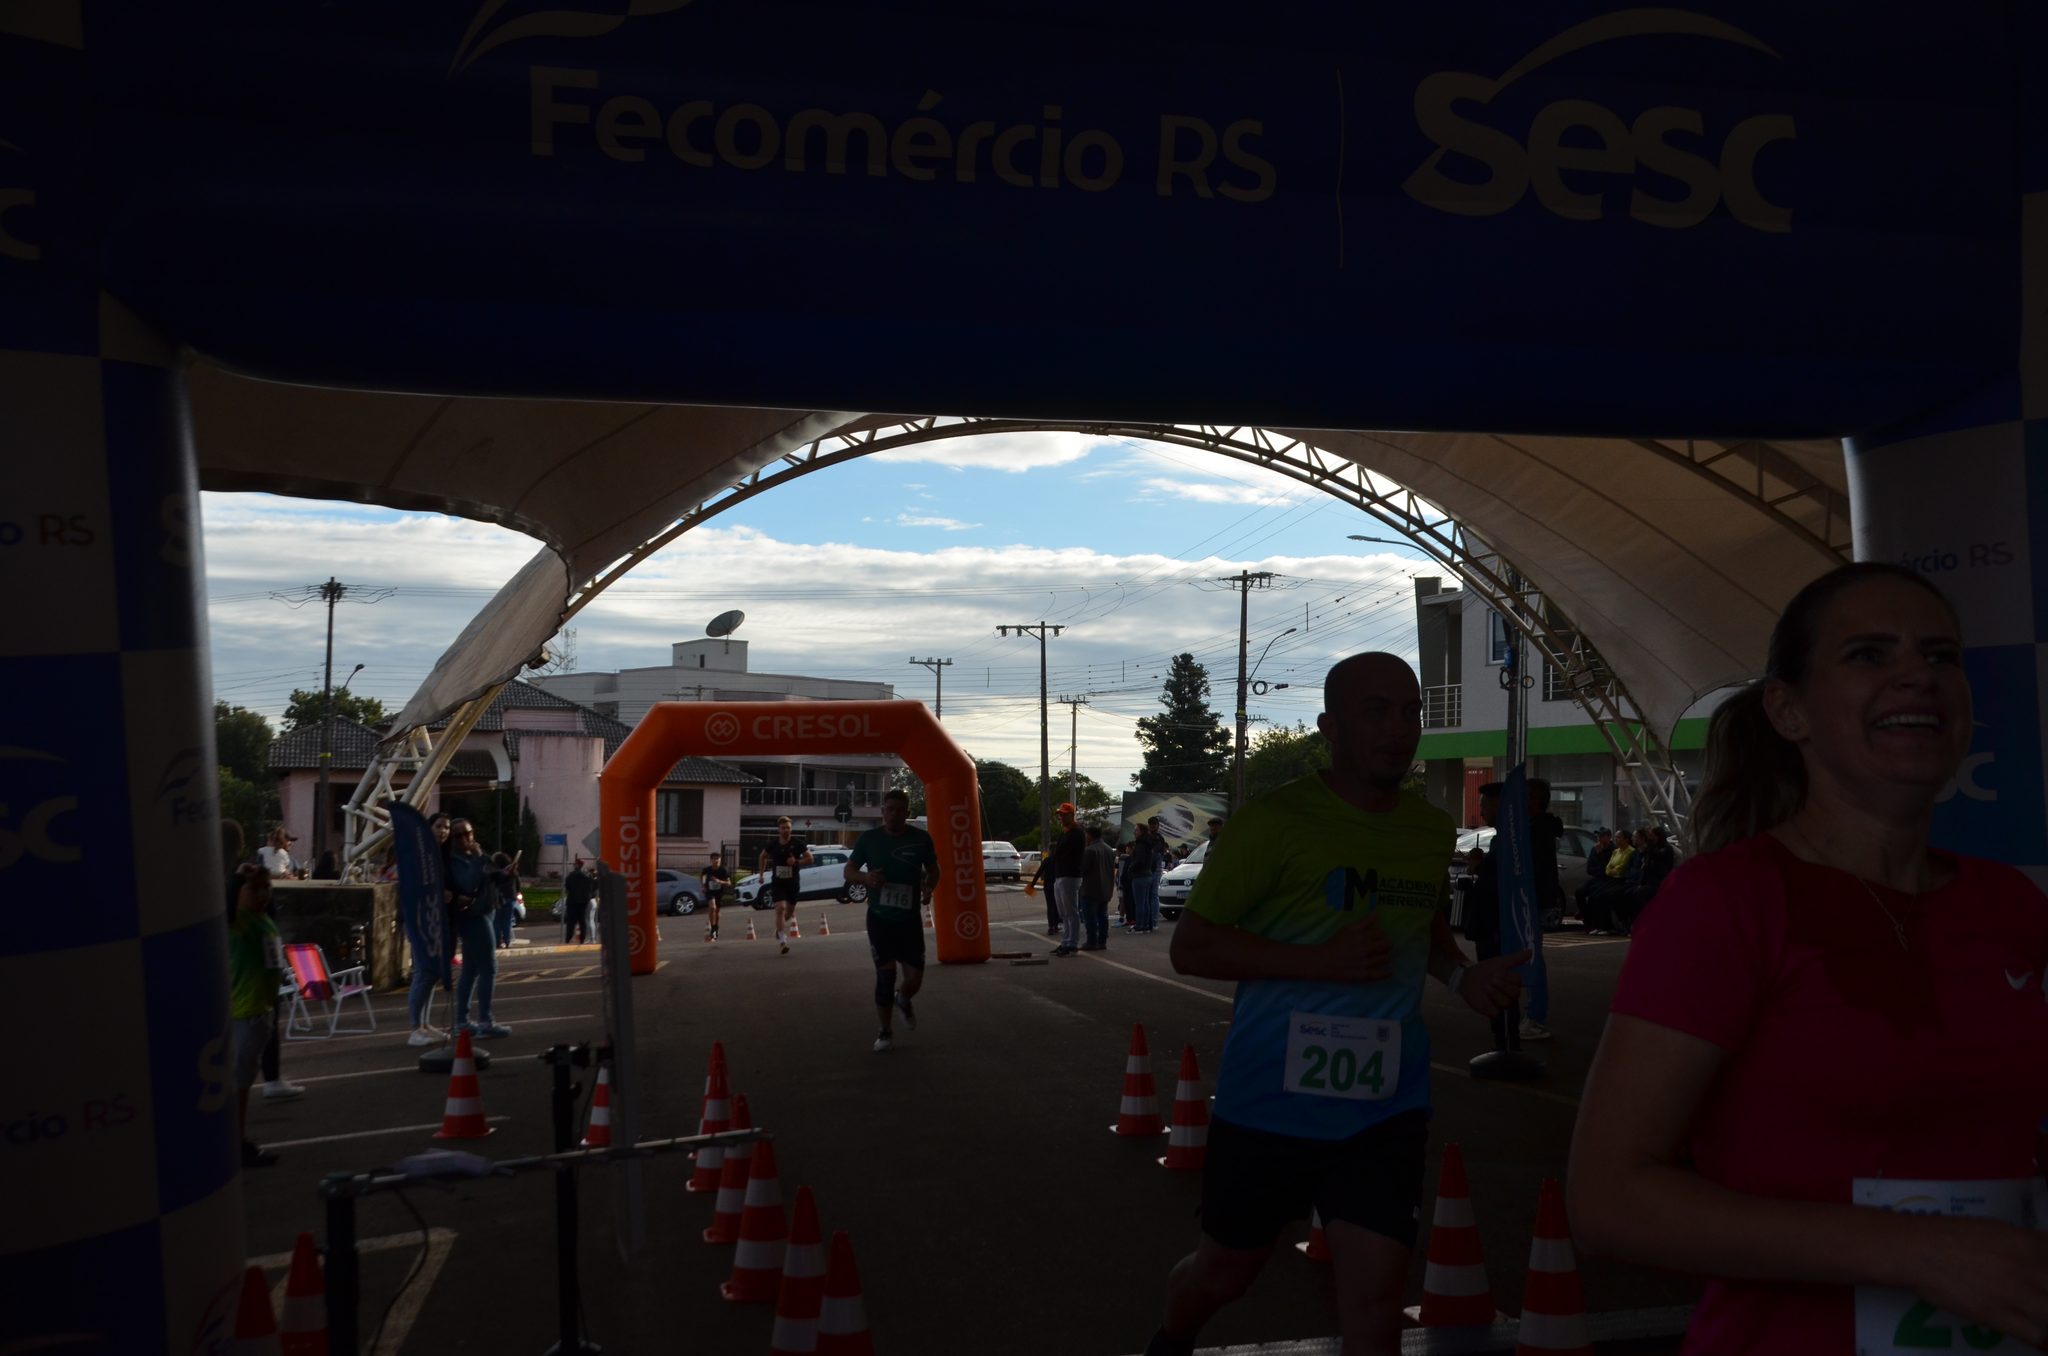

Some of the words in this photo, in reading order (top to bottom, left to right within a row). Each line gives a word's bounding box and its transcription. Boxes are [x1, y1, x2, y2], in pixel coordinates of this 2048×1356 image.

[530, 65, 1125, 193] Fecomércio
[1156, 114, 1278, 202] RS
[1400, 70, 1798, 234] Sesc
[39, 513, 95, 547] RS
[1969, 541, 2015, 568] RS
[752, 713, 881, 740] CRESOL
[950, 795, 976, 902] CRESOL
[886, 892, 908, 906] 116
[1299, 1044, 1385, 1095] 204
[83, 1093, 135, 1132] RS
